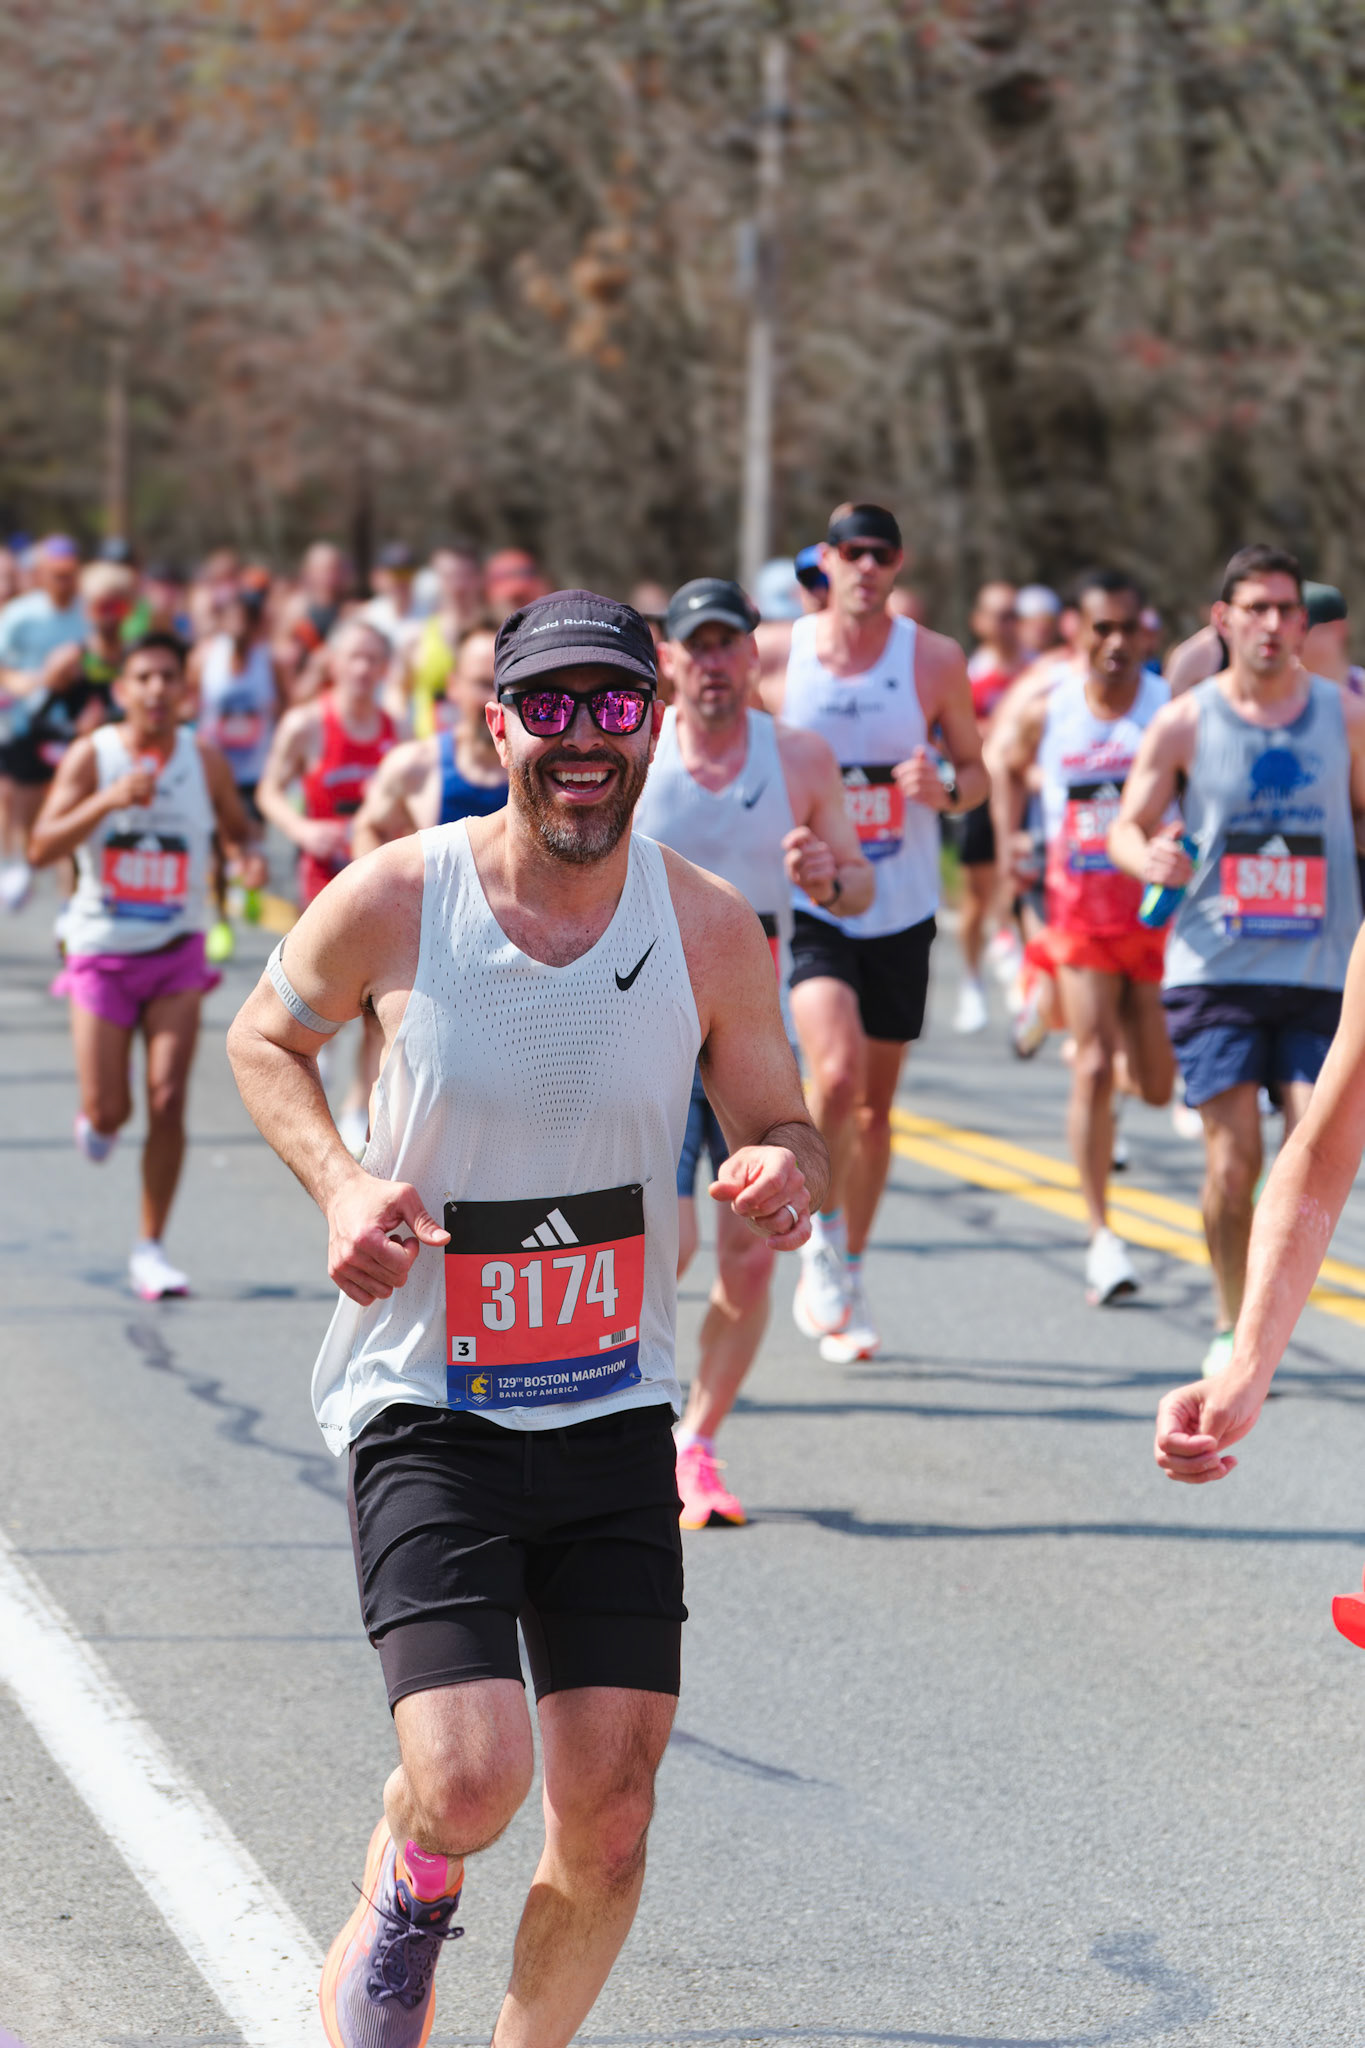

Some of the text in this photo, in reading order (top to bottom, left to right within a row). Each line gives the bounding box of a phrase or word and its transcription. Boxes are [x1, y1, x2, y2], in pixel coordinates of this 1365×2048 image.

[530, 618, 621, 636] Acid Running
[1237, 858, 1308, 901] 5241
[481, 1248, 619, 1332] 3174
[458, 1342, 470, 1357] 3
[524, 1373, 570, 1388] BOSTON
[572, 1359, 627, 1382] MARATHON
[499, 1385, 579, 1399] BANK OF AMERICA
